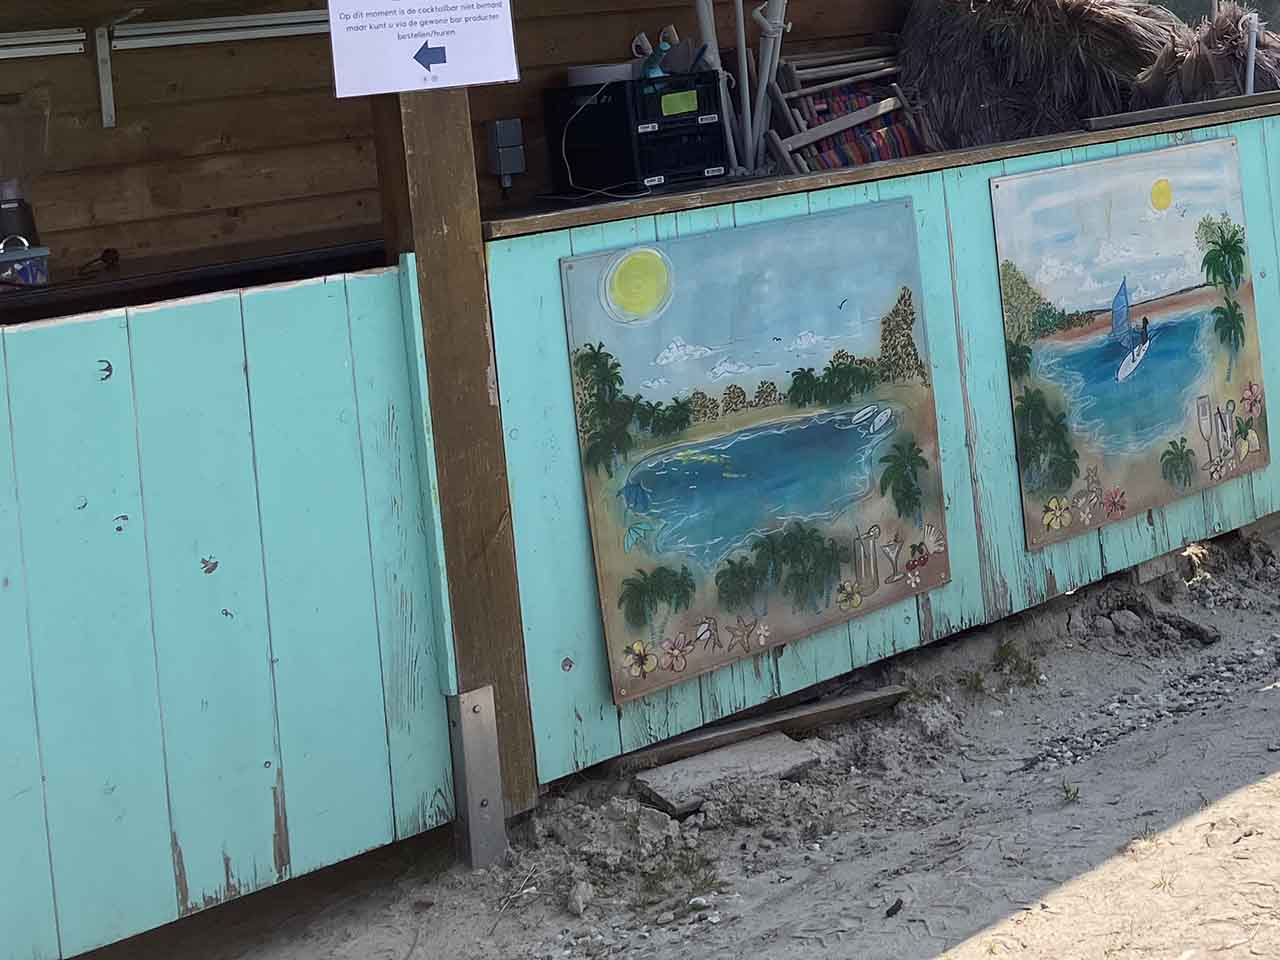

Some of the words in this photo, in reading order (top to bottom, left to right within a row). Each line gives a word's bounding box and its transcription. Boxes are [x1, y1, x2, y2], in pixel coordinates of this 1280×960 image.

[339, 12, 351, 21] Op
[352, 11, 364, 19] dit
[366, 9, 397, 18] moment
[418, 4, 458, 14] cocktailbar
[346, 24, 367, 32] maar
[369, 22, 386, 30] kunt
[419, 18, 449, 28] gewone
[449, 16, 462, 24] bar
[397, 29, 456, 40] bestellen/huren
